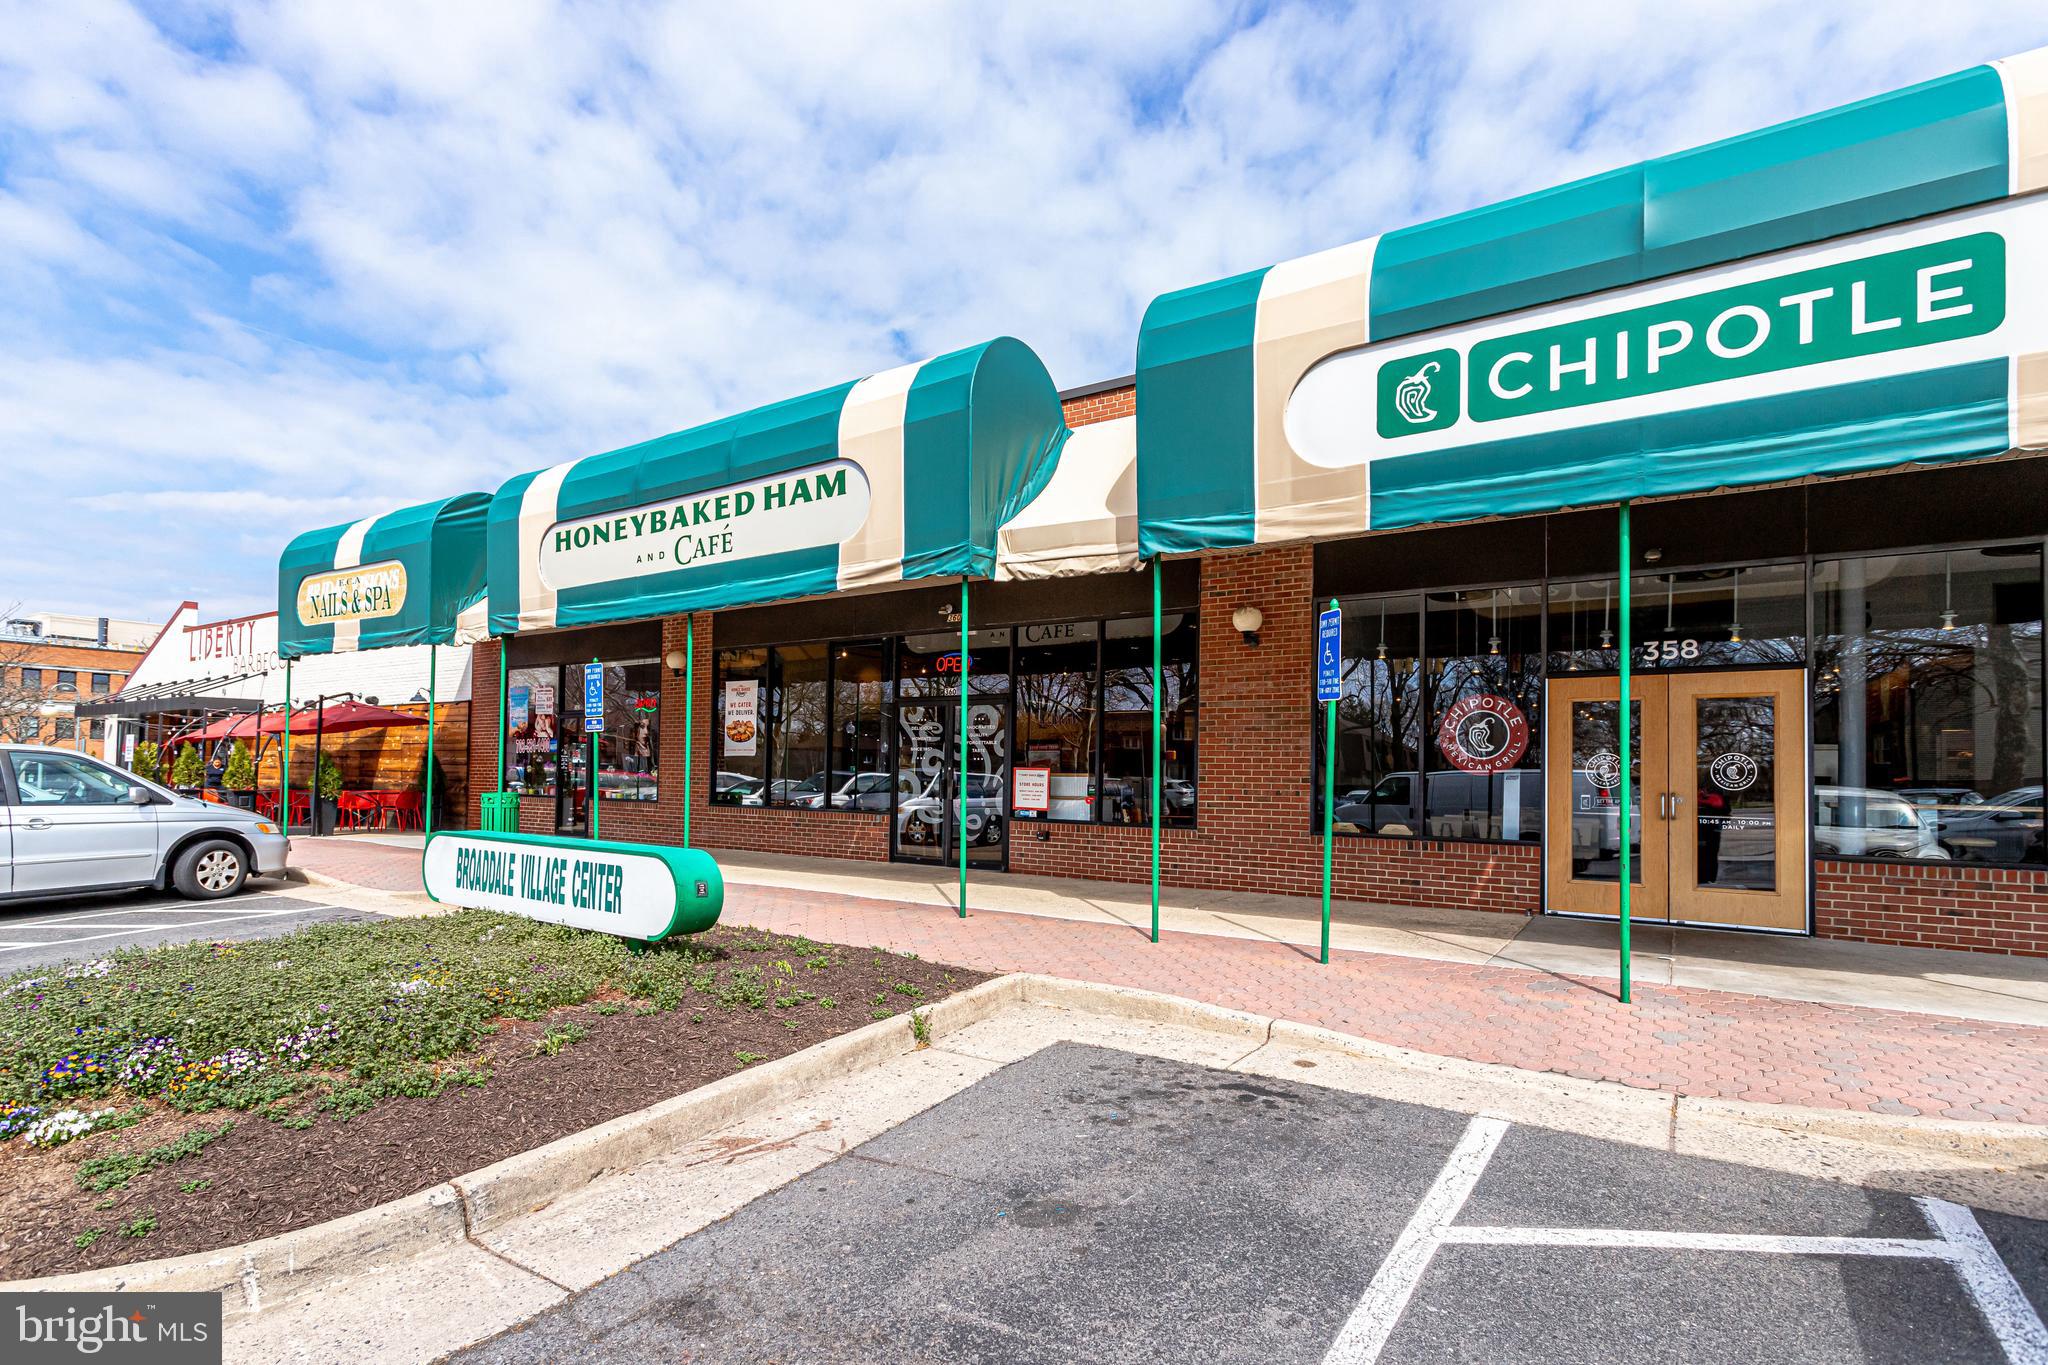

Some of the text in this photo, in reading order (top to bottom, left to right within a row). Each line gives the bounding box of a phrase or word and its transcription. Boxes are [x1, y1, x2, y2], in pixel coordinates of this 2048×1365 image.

[1488, 258, 1974, 402] CHIPOTLE
[554, 468, 848, 553] HONEYBAKED HAM
[636, 523, 734, 566] AND CAFÉ
[310, 590, 347, 619] NAILS
[351, 589, 361, 614] &
[364, 584, 392, 613] SPA
[189, 620, 256, 662] LIBERTY
[1643, 639, 1700, 661] 358
[232, 650, 295, 675] BARBEC
[1444, 697, 1523, 729] CHIPOTLE
[1446, 741, 1522, 770] MEXICAN GRILL
[1588, 755, 1621, 769] CHIPOTL
[1714, 755, 1754, 770] CHIPOTLE
[455, 846, 623, 914] BROADDALE VILLAGE CENTER
